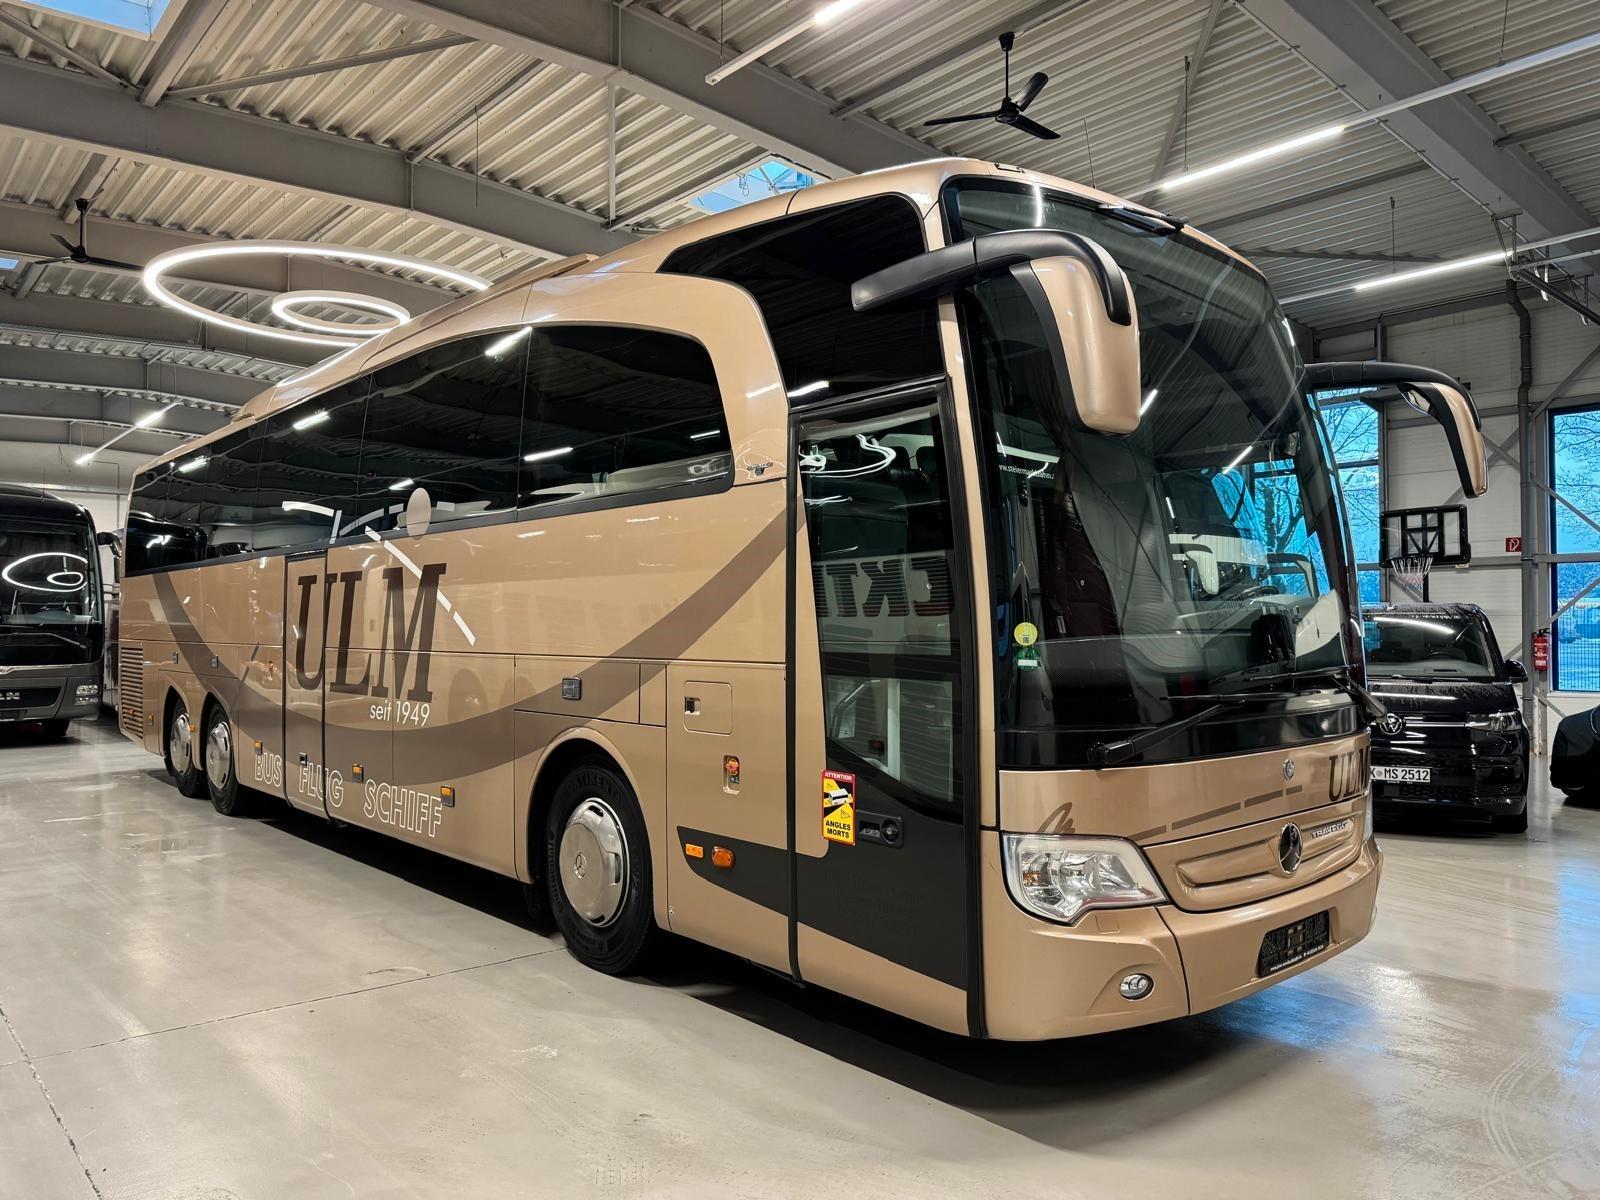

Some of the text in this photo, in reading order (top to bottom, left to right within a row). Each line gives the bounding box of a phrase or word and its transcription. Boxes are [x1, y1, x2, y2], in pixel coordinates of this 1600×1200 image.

[296, 563, 446, 703] ULM
[369, 699, 431, 728] seit 1949
[824, 772, 854, 781] ATTENTION
[1384, 768, 1399, 780] MS
[1401, 769, 1430, 781] 2512
[254, 752, 443, 838] BUS FLUG SCHIFF
[825, 820, 851, 831] ANGLES
[826, 828, 850, 839] MORTS
